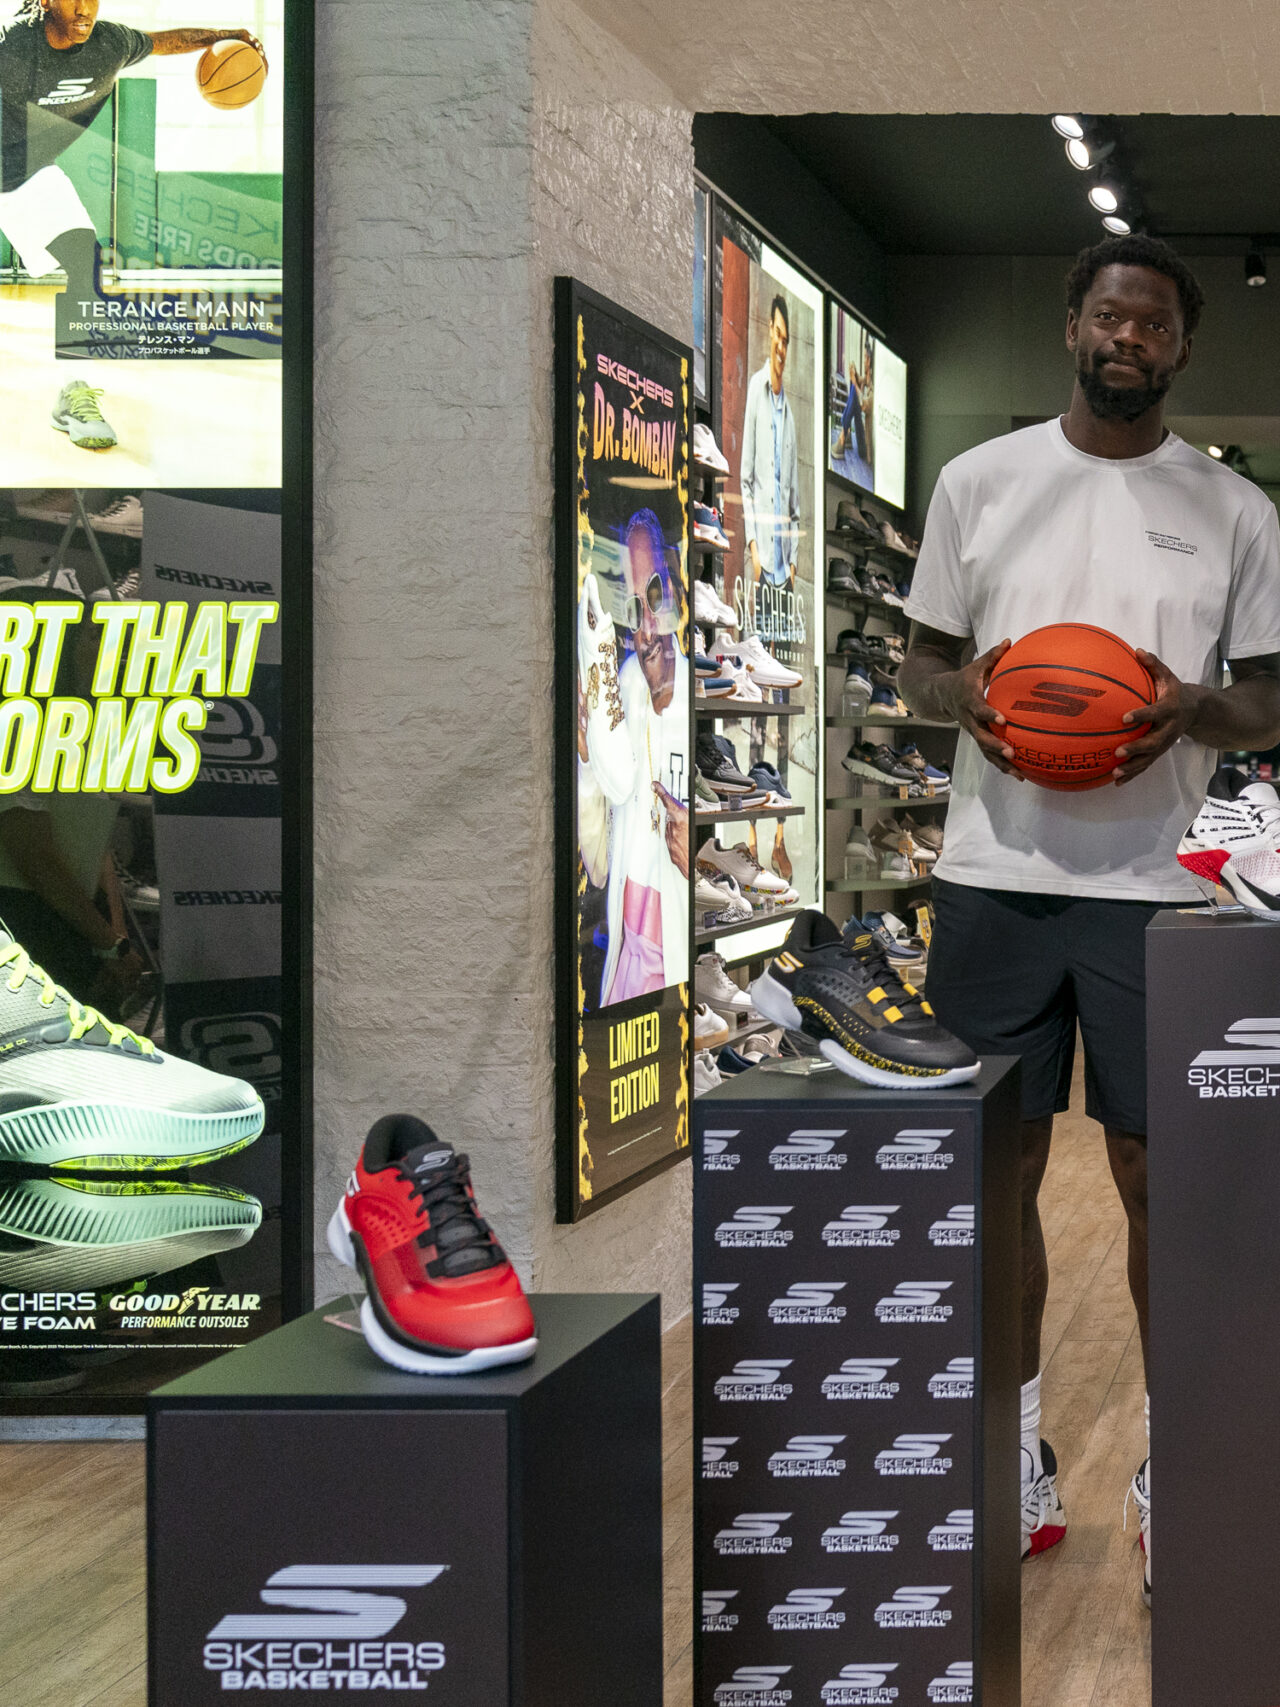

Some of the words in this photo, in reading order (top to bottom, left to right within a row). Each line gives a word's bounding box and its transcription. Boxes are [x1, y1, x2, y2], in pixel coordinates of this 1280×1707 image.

[78, 301, 188, 317] TERANCE
[195, 301, 265, 317] MANN
[69, 322, 154, 331] PROFESSIONAL
[157, 322, 228, 331] BASKETBALL
[232, 322, 274, 331] PLAYER
[597, 353, 674, 408] SKECHERS
[630, 390, 644, 414] X
[622, 407, 676, 489] BOMBAY
[1148, 535, 1198, 552] SKECHERS
[735, 575, 805, 645] SKECHERS
[91, 601, 280, 697] THAT
[609, 1011, 660, 1070] LIMITED
[610, 1062, 660, 1124] EDITION
[769, 1154, 847, 1164] SKECHERS
[876, 1153, 954, 1164] SKECHERS
[881, 1162, 948, 1170] BASKETBALL
[714, 1230, 794, 1241] SKECHERS
[822, 1230, 900, 1240] SKECHERS
[827, 1239, 894, 1247] BASKETBALL
[768, 1306, 846, 1317] SKECHERS
[875, 1306, 953, 1316] SKECHERS
[24, 1317, 96, 1330] FOAM
[121, 1316, 196, 1328] PERFORMANCE
[199, 1316, 249, 1328] OUTSOLES
[714, 1384, 793, 1394] SKECHERS
[821, 1382, 900, 1393] SKECHERS
[720, 1393, 787, 1401] BASKETBALL
[826, 1392, 894, 1400] BASKETBALL
[768, 1460, 846, 1470] SKECHERS
[874, 1458, 952, 1468] SKECHERS
[773, 1469, 840, 1477] BASKETBALL
[714, 1537, 792, 1548] SKECHERS
[821, 1535, 899, 1546] SKECHERS
[719, 1546, 786, 1554] BASKETBALL
[826, 1544, 893, 1552] BASKETBALL
[768, 1612, 846, 1623] SKECHERS
[874, 1610, 952, 1621] SKECHERS
[773, 1622, 840, 1630] BASKETBALL
[880, 1620, 946, 1628] BASKETBALL
[203, 1642, 446, 1671] SKECHERS
[221, 1670, 428, 1690] BASKETBALL
[714, 1690, 792, 1701] SKECHERS
[821, 1688, 898, 1698] SKECHERS
